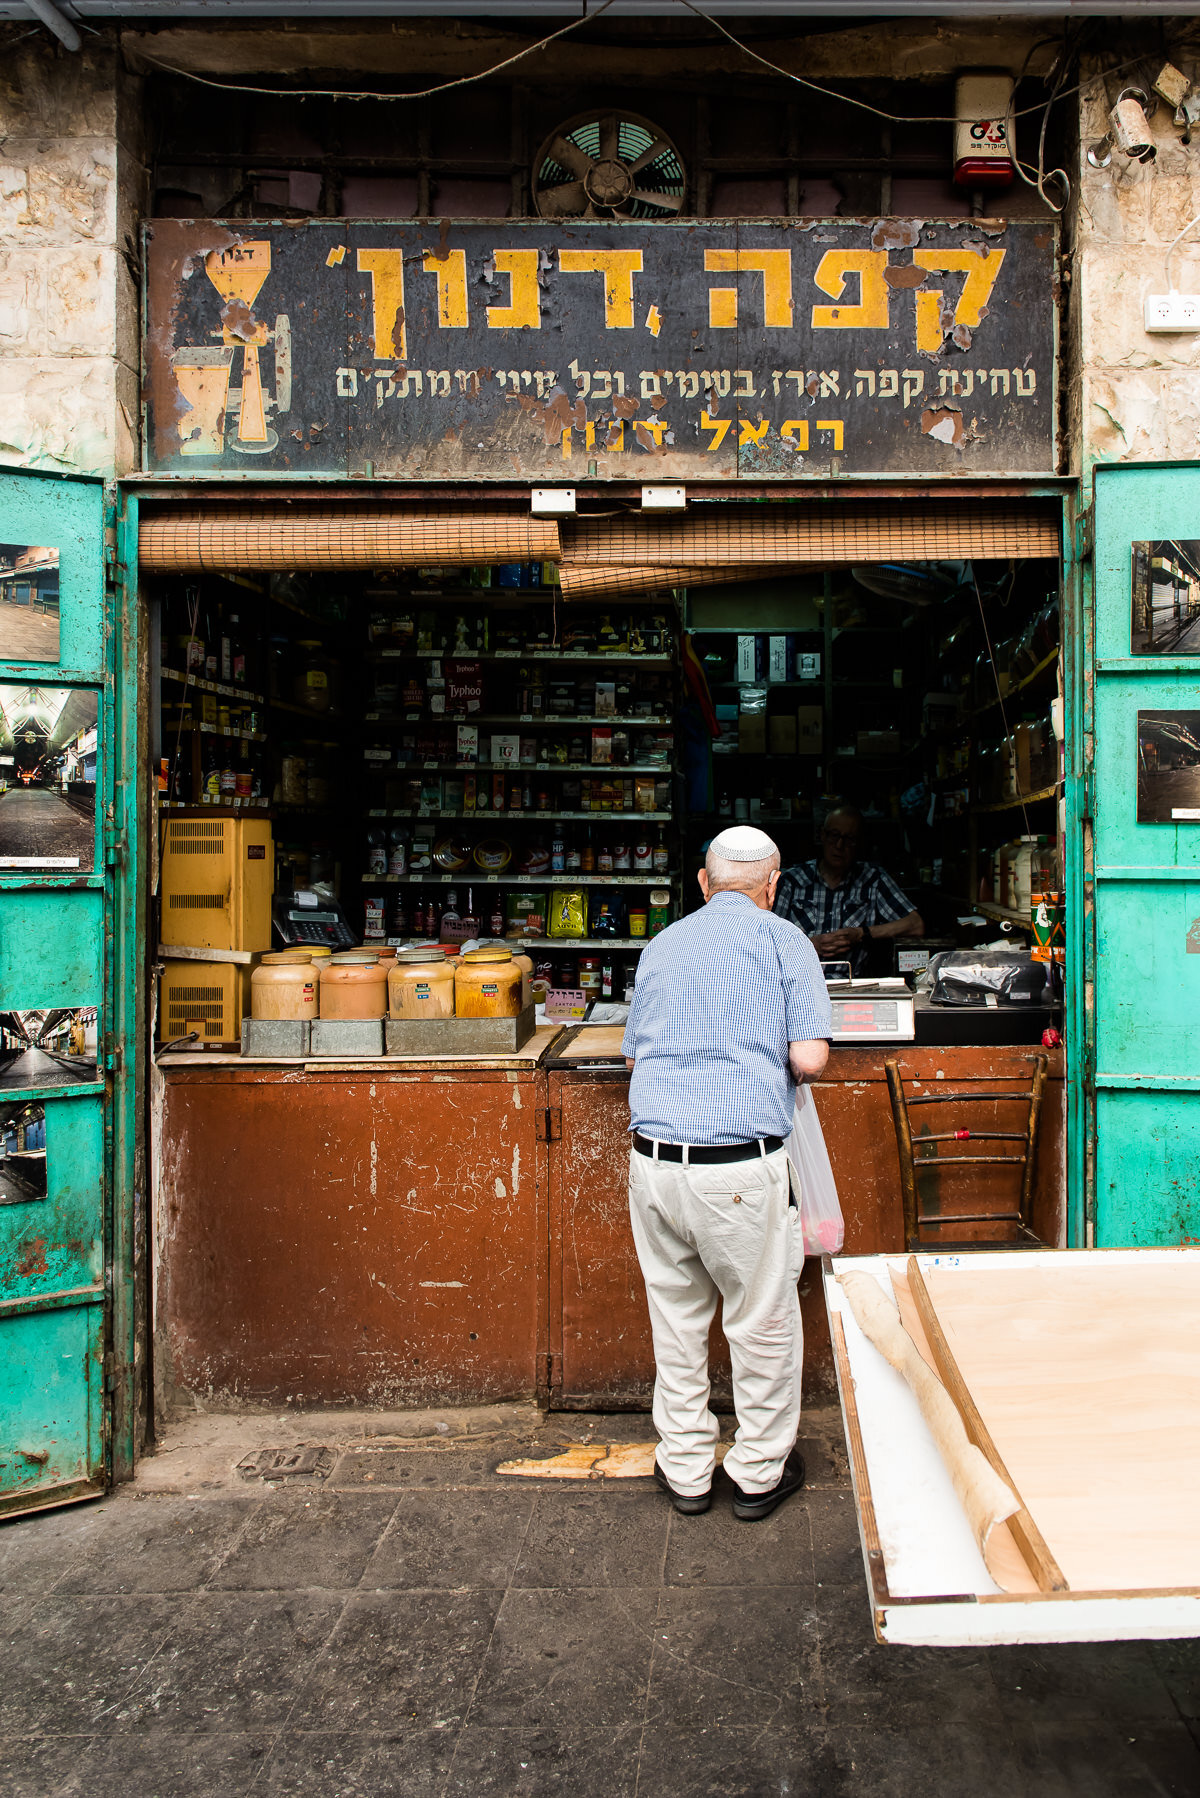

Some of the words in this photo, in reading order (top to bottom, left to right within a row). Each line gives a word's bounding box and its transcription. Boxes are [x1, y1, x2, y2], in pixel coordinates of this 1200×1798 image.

[970, 122, 1006, 143] G4S
[703, 247, 1007, 354] קפה
[568, 358, 625, 399] וכל
[937, 368, 1037, 397] טחינת
[701, 410, 845, 451] רפאל
[456, 664, 475, 673] Typhoo
[448, 684, 482, 698] Typhoo
[458, 737, 477, 747] Typhoo
[552, 844, 564, 852] HP
[547, 989, 583, 1000] ברזיל
